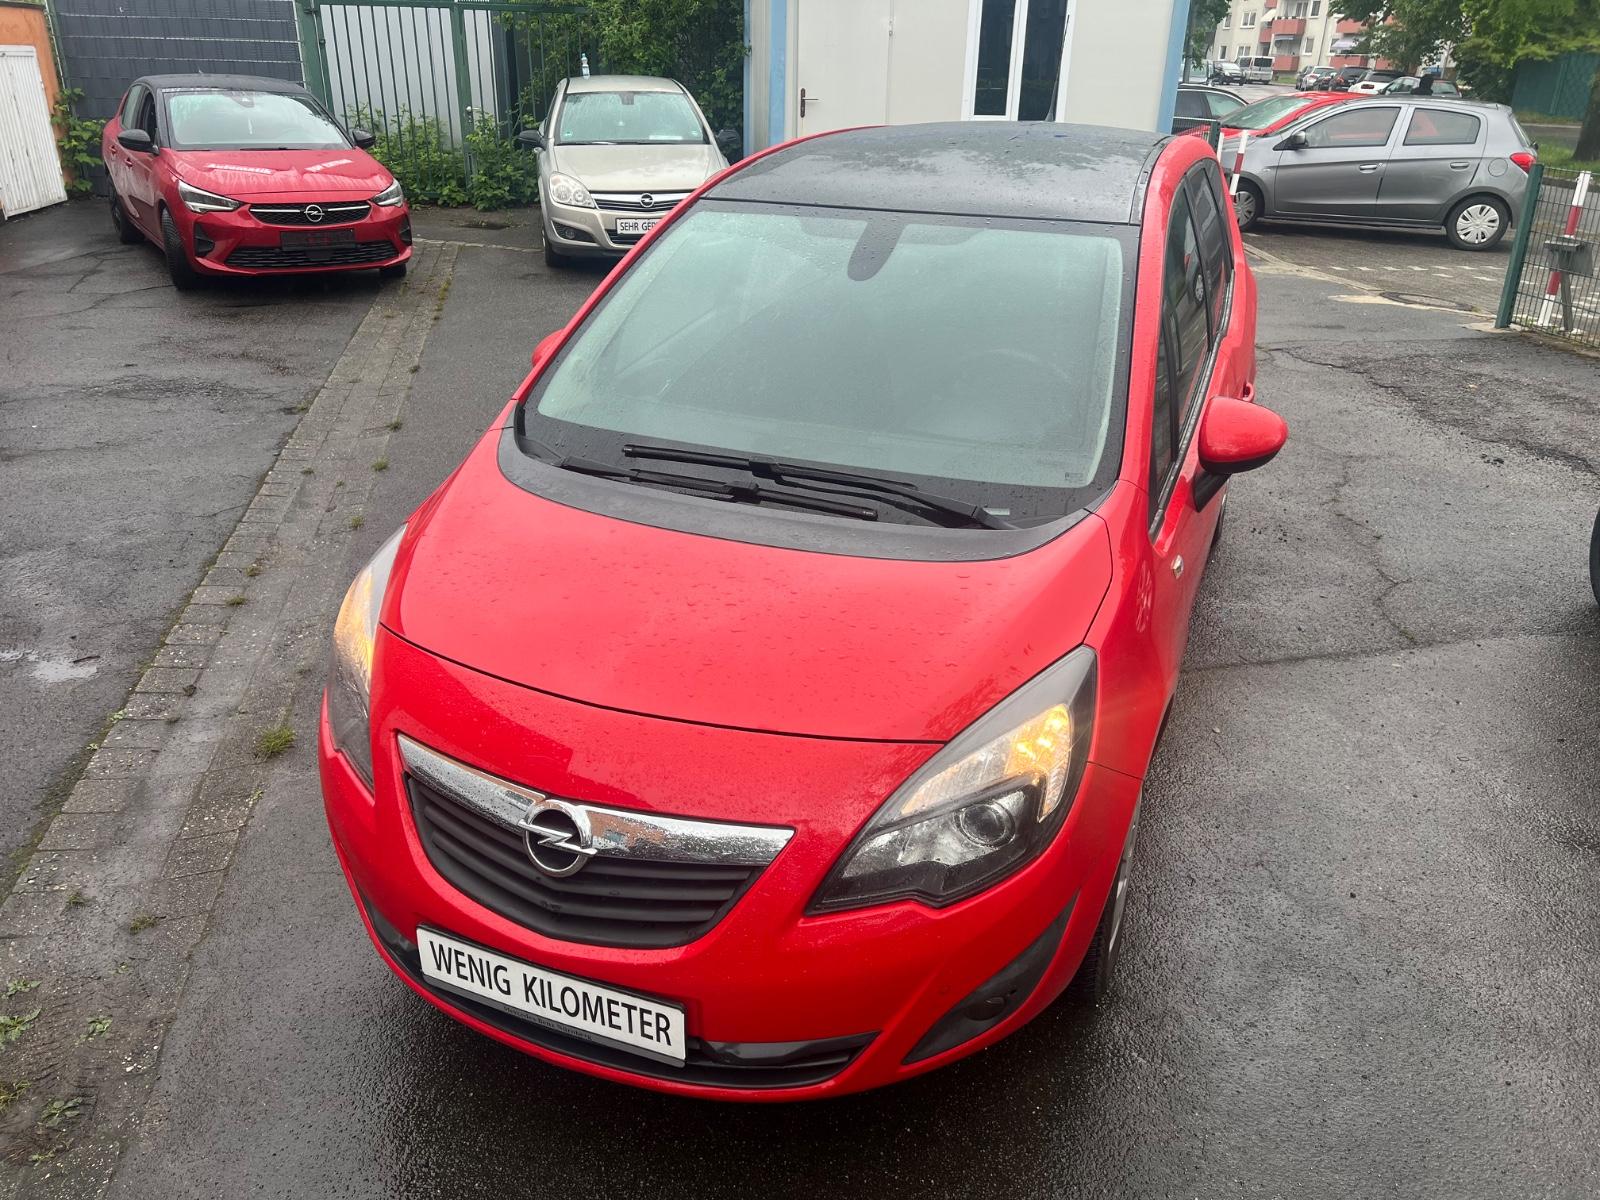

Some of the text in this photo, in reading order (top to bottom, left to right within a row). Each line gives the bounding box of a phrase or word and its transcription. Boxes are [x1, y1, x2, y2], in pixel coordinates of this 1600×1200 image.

[620, 222, 639, 231] SEHR
[429, 940, 672, 1046] WENIG KILOMETER
